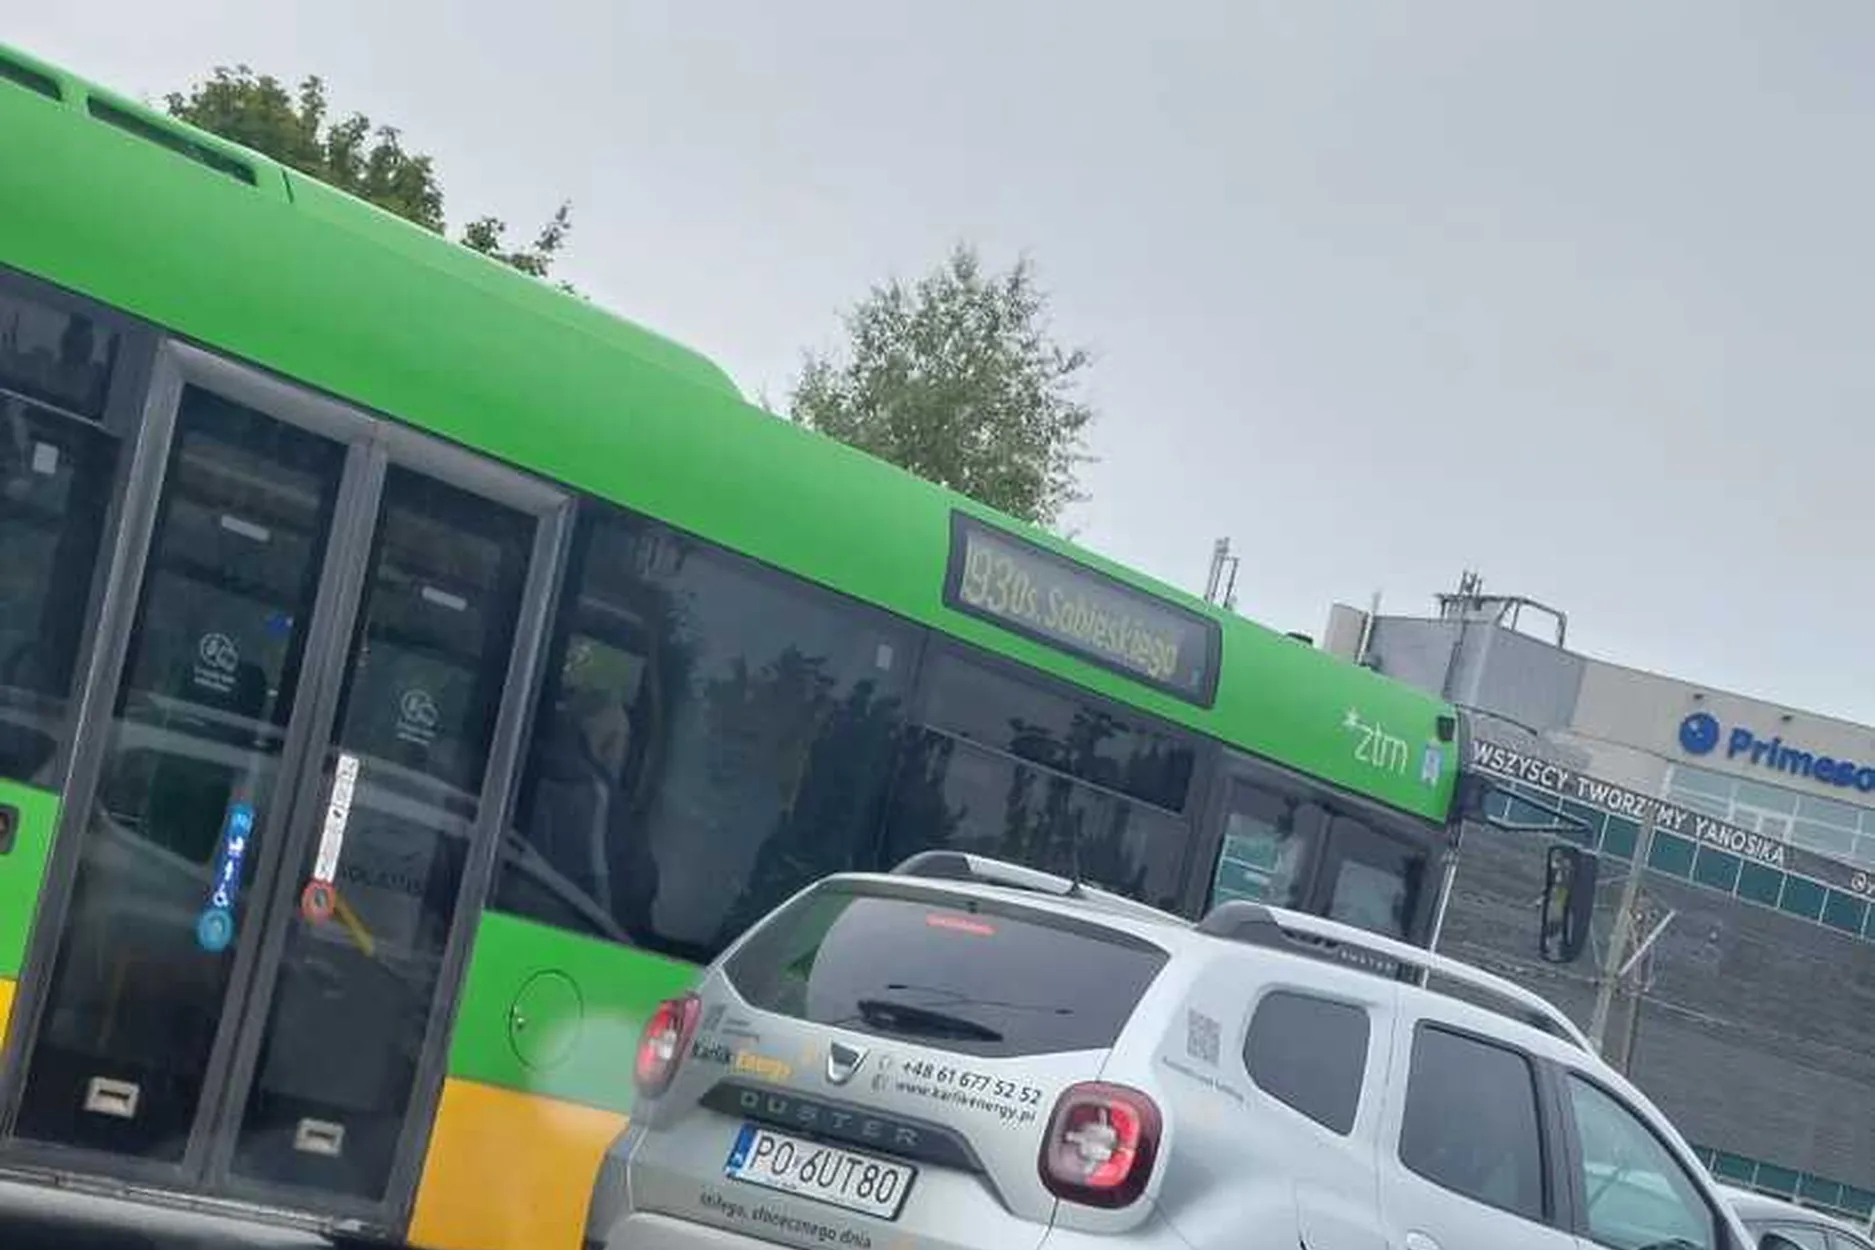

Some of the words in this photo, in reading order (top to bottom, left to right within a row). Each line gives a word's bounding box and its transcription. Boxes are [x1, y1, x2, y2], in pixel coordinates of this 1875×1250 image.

[1043, 588, 1178, 679] Sobieskiego
[1353, 721, 1408, 776] ztm
[1472, 739, 1569, 791] WSZYSCY
[1695, 817, 1785, 868] YANOSIKA
[902, 1060, 935, 1080] +48
[936, 1065, 957, 1084] 61
[959, 1071, 991, 1092] 677
[993, 1079, 1017, 1099] 52
[1018, 1085, 1042, 1105] 52
[740, 1090, 919, 1146] DUSTER
[799, 1149, 899, 1205] 6UT80
